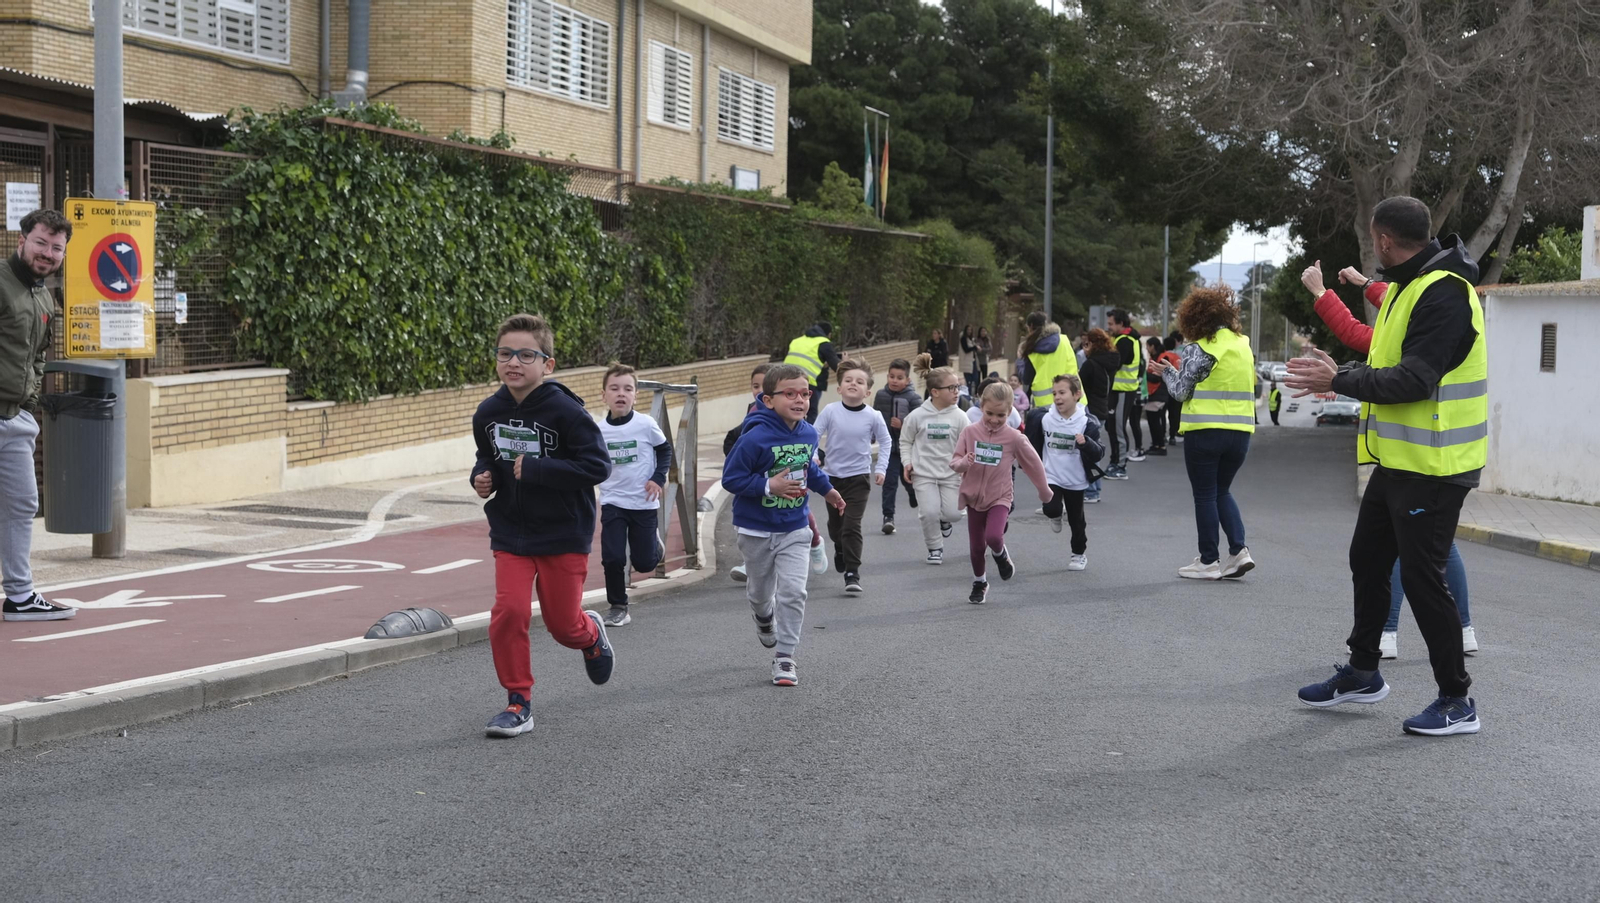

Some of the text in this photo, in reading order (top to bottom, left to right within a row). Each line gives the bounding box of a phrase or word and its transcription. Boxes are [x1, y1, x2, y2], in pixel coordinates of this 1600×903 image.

[118, 209, 153, 217] AYUNTAMIENTO
[69, 307, 99, 316] ESTACIO
[510, 441, 528, 451] 068
[761, 496, 805, 509] DINO
